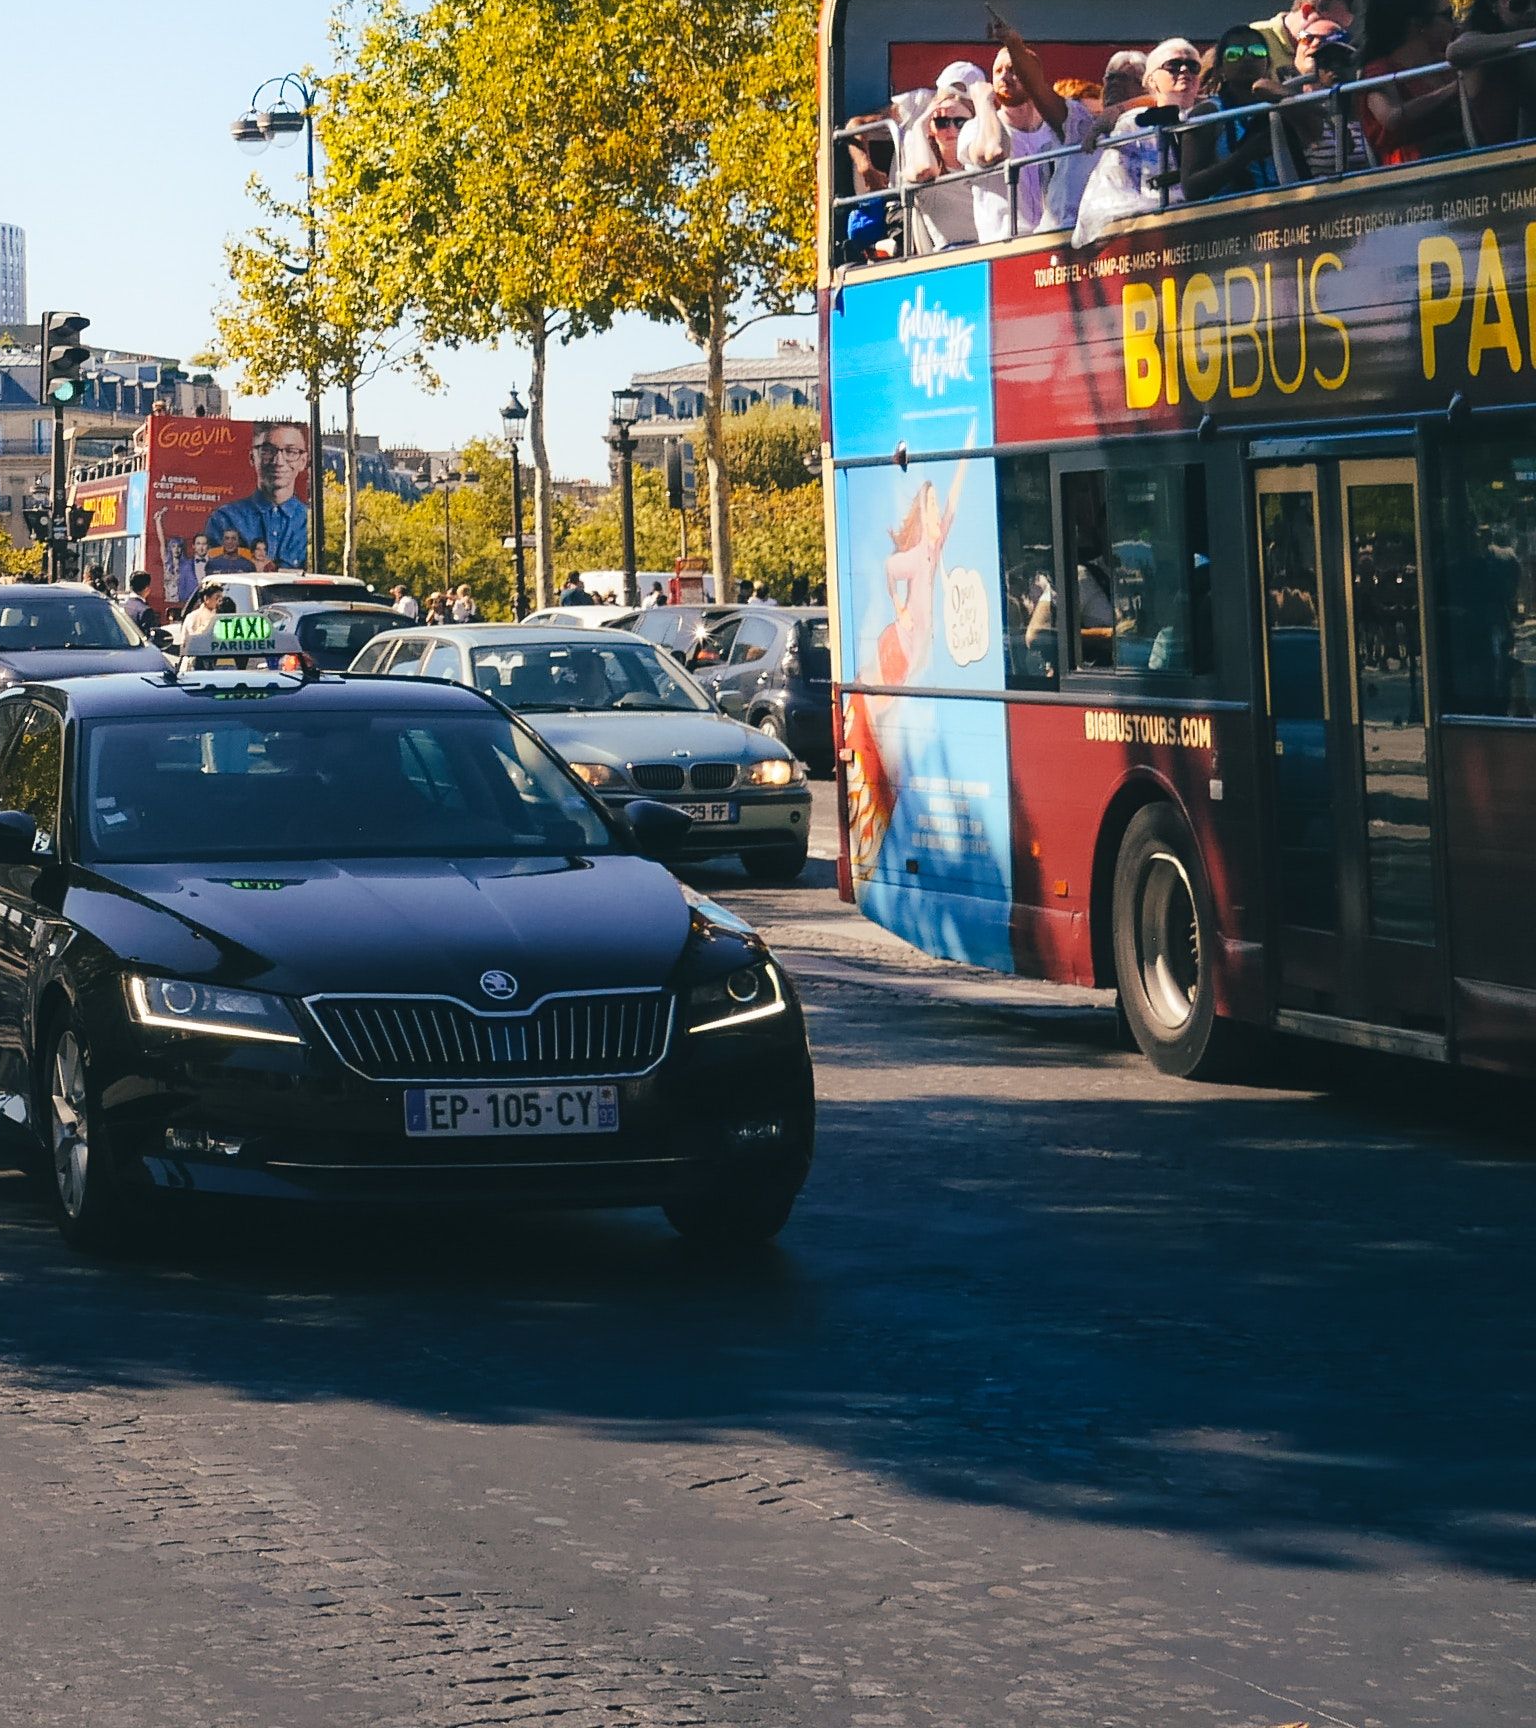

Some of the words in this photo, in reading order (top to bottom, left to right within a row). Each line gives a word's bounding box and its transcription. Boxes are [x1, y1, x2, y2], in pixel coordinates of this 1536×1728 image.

[1033, 268, 1055, 289] TOUR
[1055, 264, 1082, 285] EIFFEL
[1088, 250, 1158, 280] CHAMP-DE-MARS
[1162, 242, 1191, 269] MUSÉE
[1193, 244, 1206, 262] DU
[1207, 236, 1242, 258] LOUVRE
[1249, 223, 1311, 252] NOTRE-DAME
[1319, 213, 1353, 240] MUSÉE
[1354, 209, 1397, 235] D'ORSAY
[1441, 194, 1490, 221] GARNIER
[1418, 222, 1536, 381] PA
[211, 639, 276, 652] PARISIEN
[220, 617, 265, 640] TAXI
[1084, 710, 1212, 750] BIGBUSTOURS.COM
[429, 1090, 594, 1130] EP-105-CY
